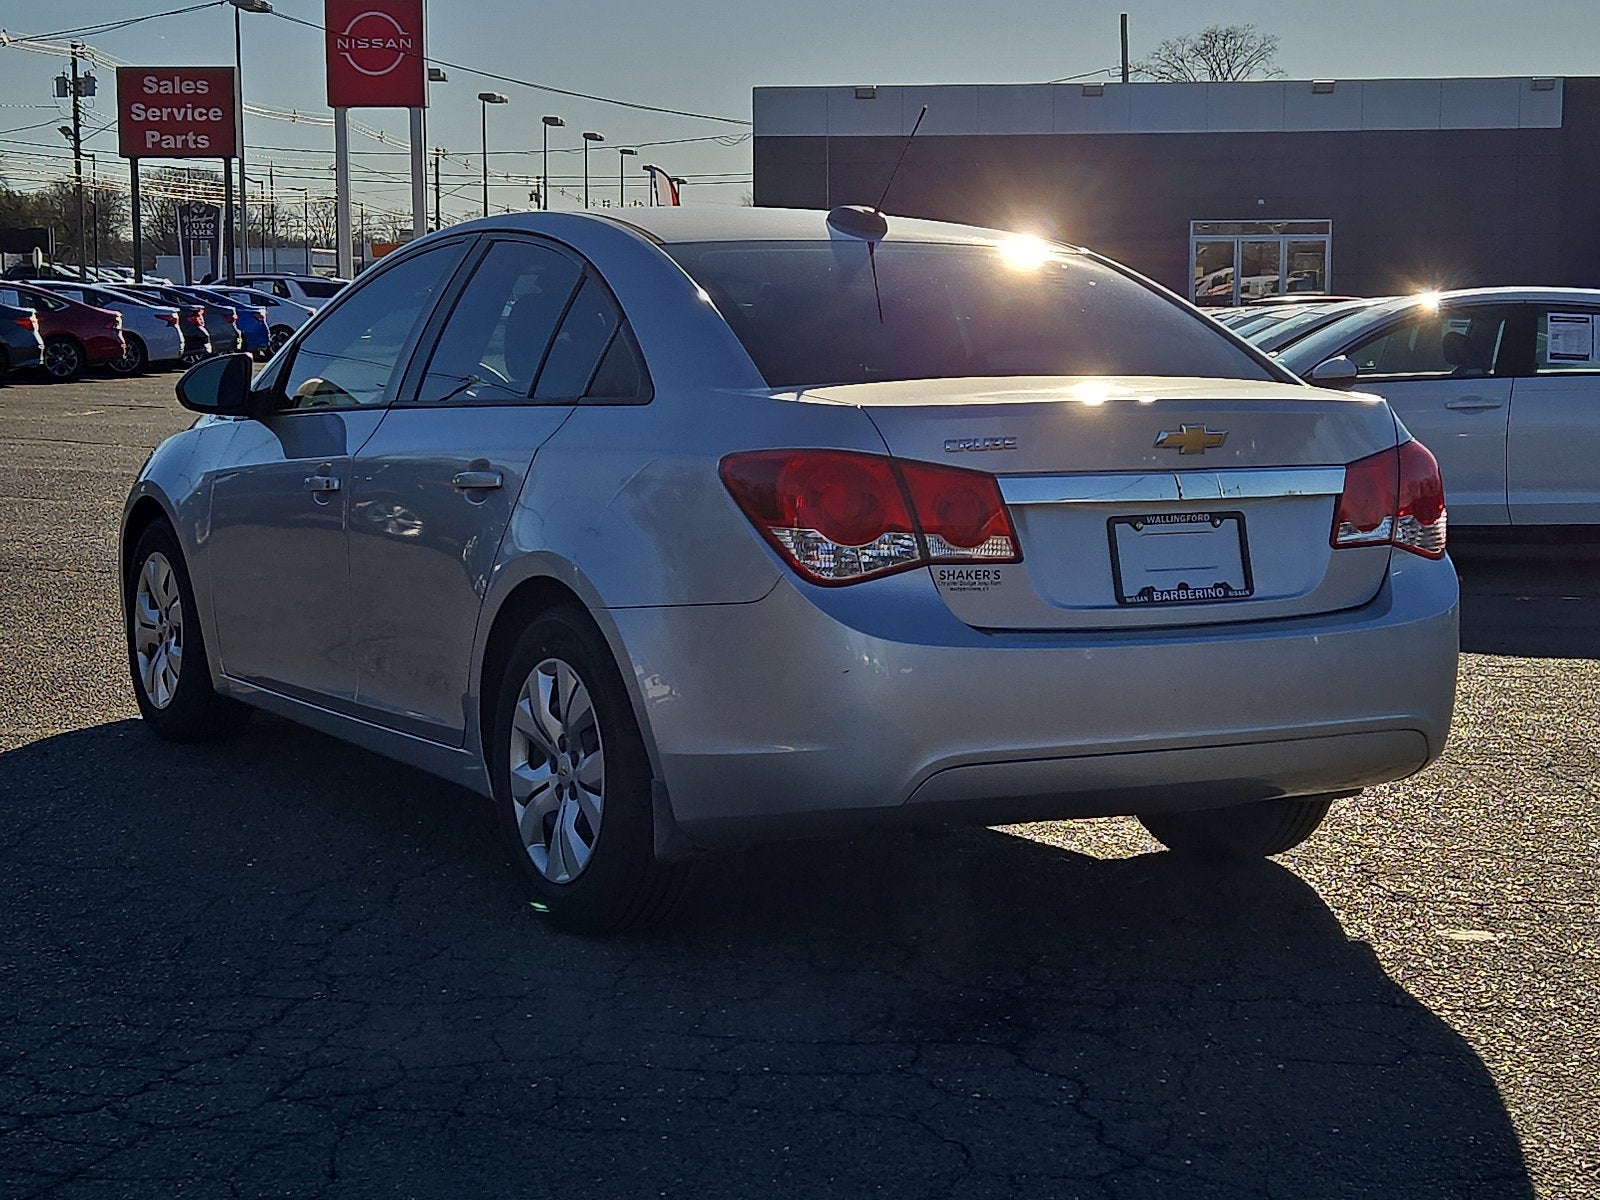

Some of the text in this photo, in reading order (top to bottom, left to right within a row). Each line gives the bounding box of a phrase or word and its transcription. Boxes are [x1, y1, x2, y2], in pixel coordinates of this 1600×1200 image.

[337, 38, 412, 49] NISSAN
[142, 75, 210, 95] Sales
[130, 102, 223, 122] Service
[145, 130, 210, 149] Parts
[944, 436, 1017, 453] CRUZE
[1146, 513, 1210, 524] WALLINGFORD
[939, 569, 1001, 581] SHAKER'S
[1153, 588, 1225, 601] BARBERINO
